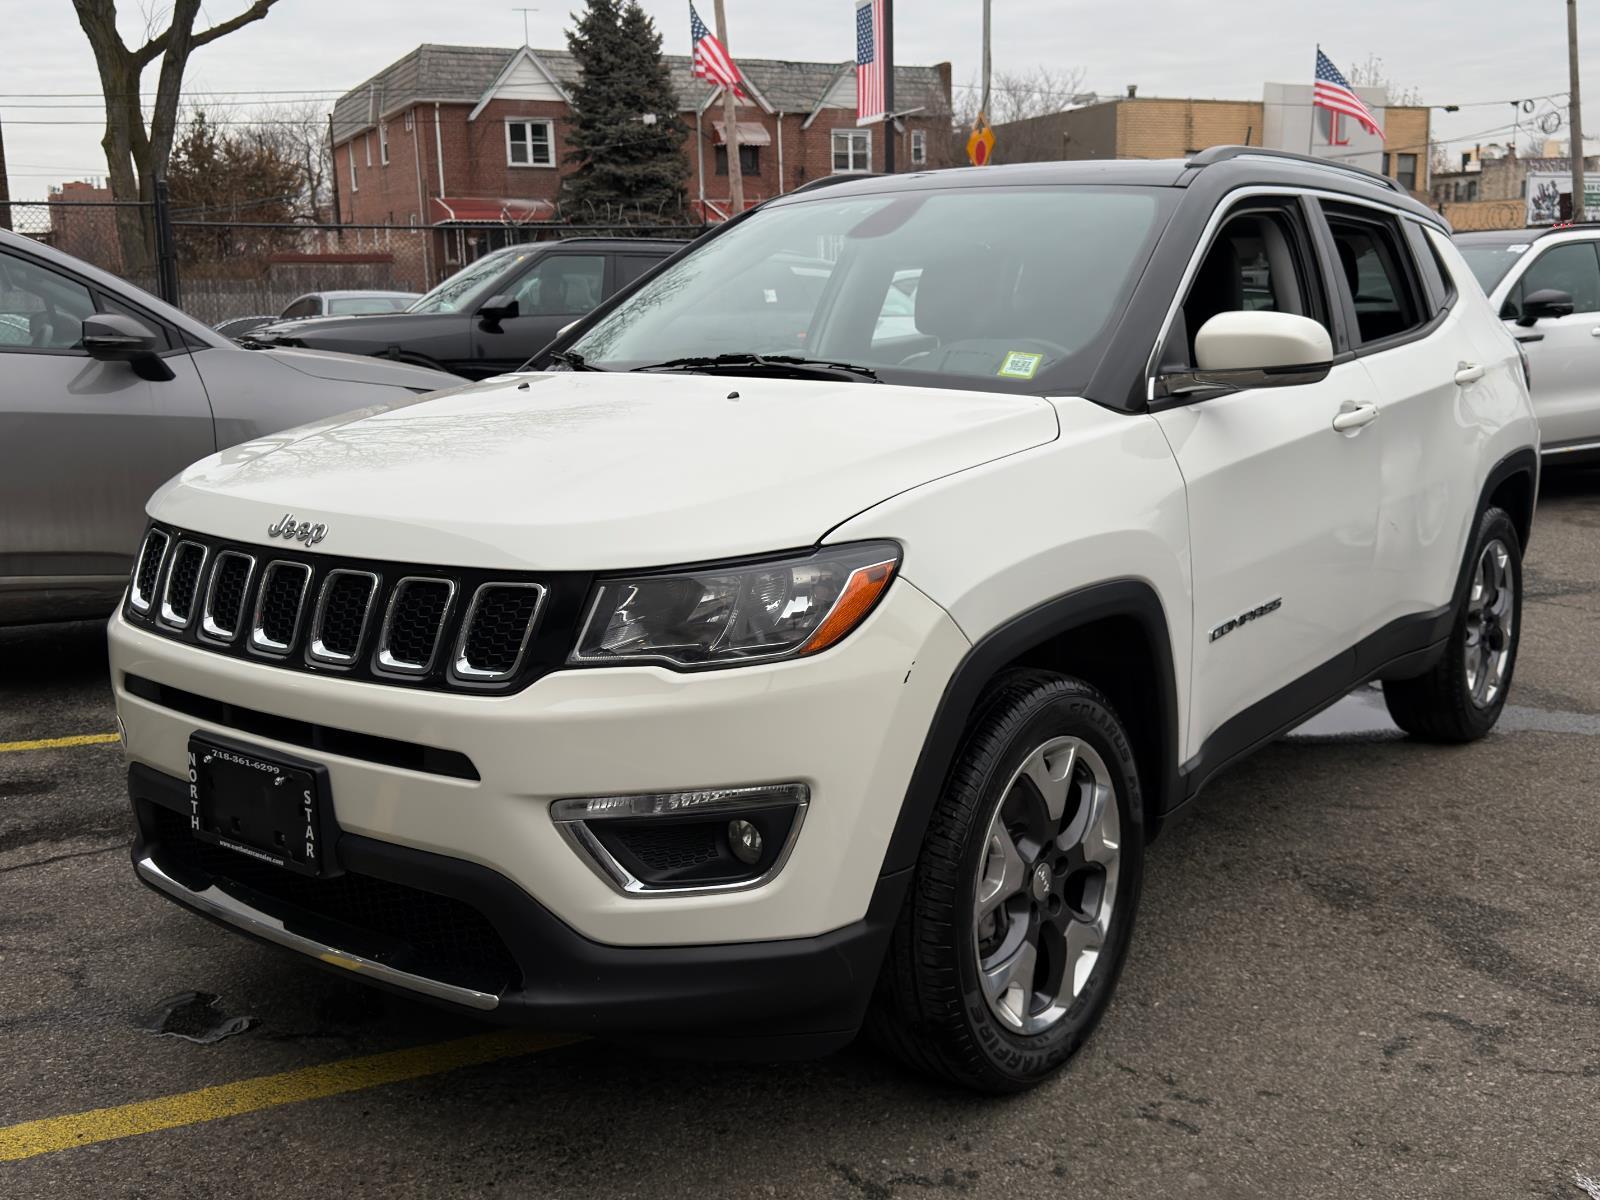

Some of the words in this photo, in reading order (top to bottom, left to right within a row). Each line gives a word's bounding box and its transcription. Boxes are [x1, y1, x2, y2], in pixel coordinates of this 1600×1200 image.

[268, 514, 328, 547] Jeep
[1209, 597, 1282, 643] COMPASS
[212, 749, 280, 774] 718-361-6299
[188, 751, 200, 830] NORTH
[304, 790, 315, 858] STAR
[969, 1006, 1059, 1072] STARFIRE
